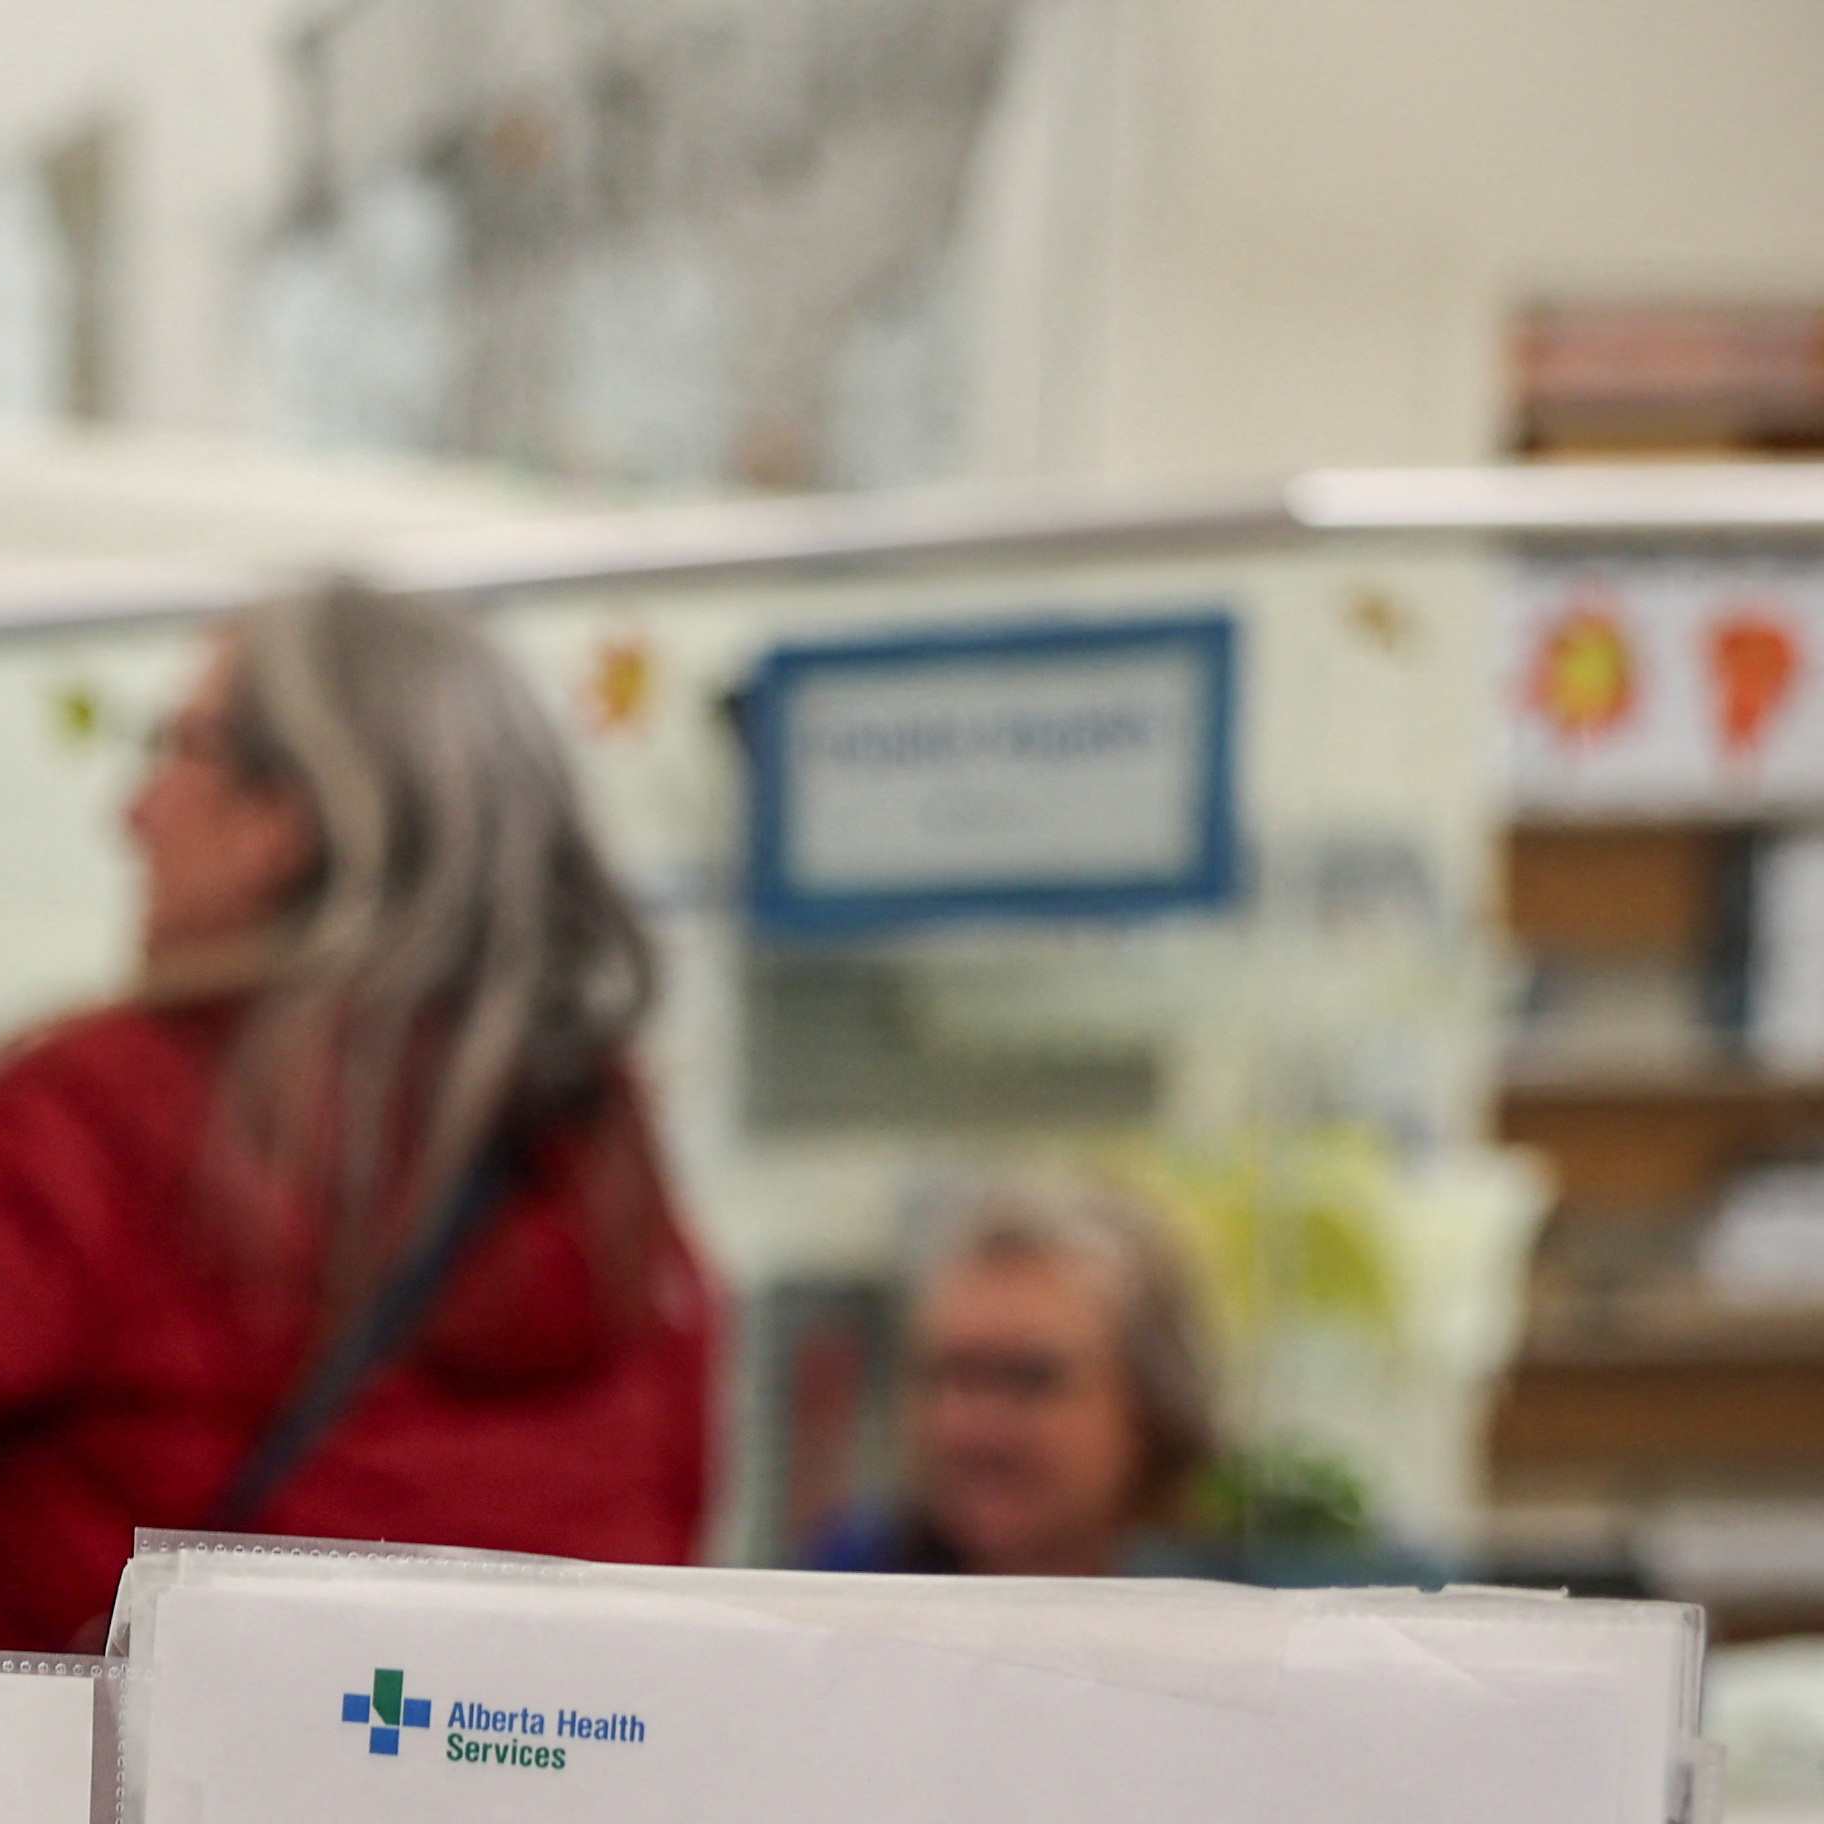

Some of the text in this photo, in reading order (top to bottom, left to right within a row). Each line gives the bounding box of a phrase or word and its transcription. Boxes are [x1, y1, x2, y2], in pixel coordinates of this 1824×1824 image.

[446, 1700, 647, 1745] Alberta Health
[445, 1733, 566, 1771] Services
